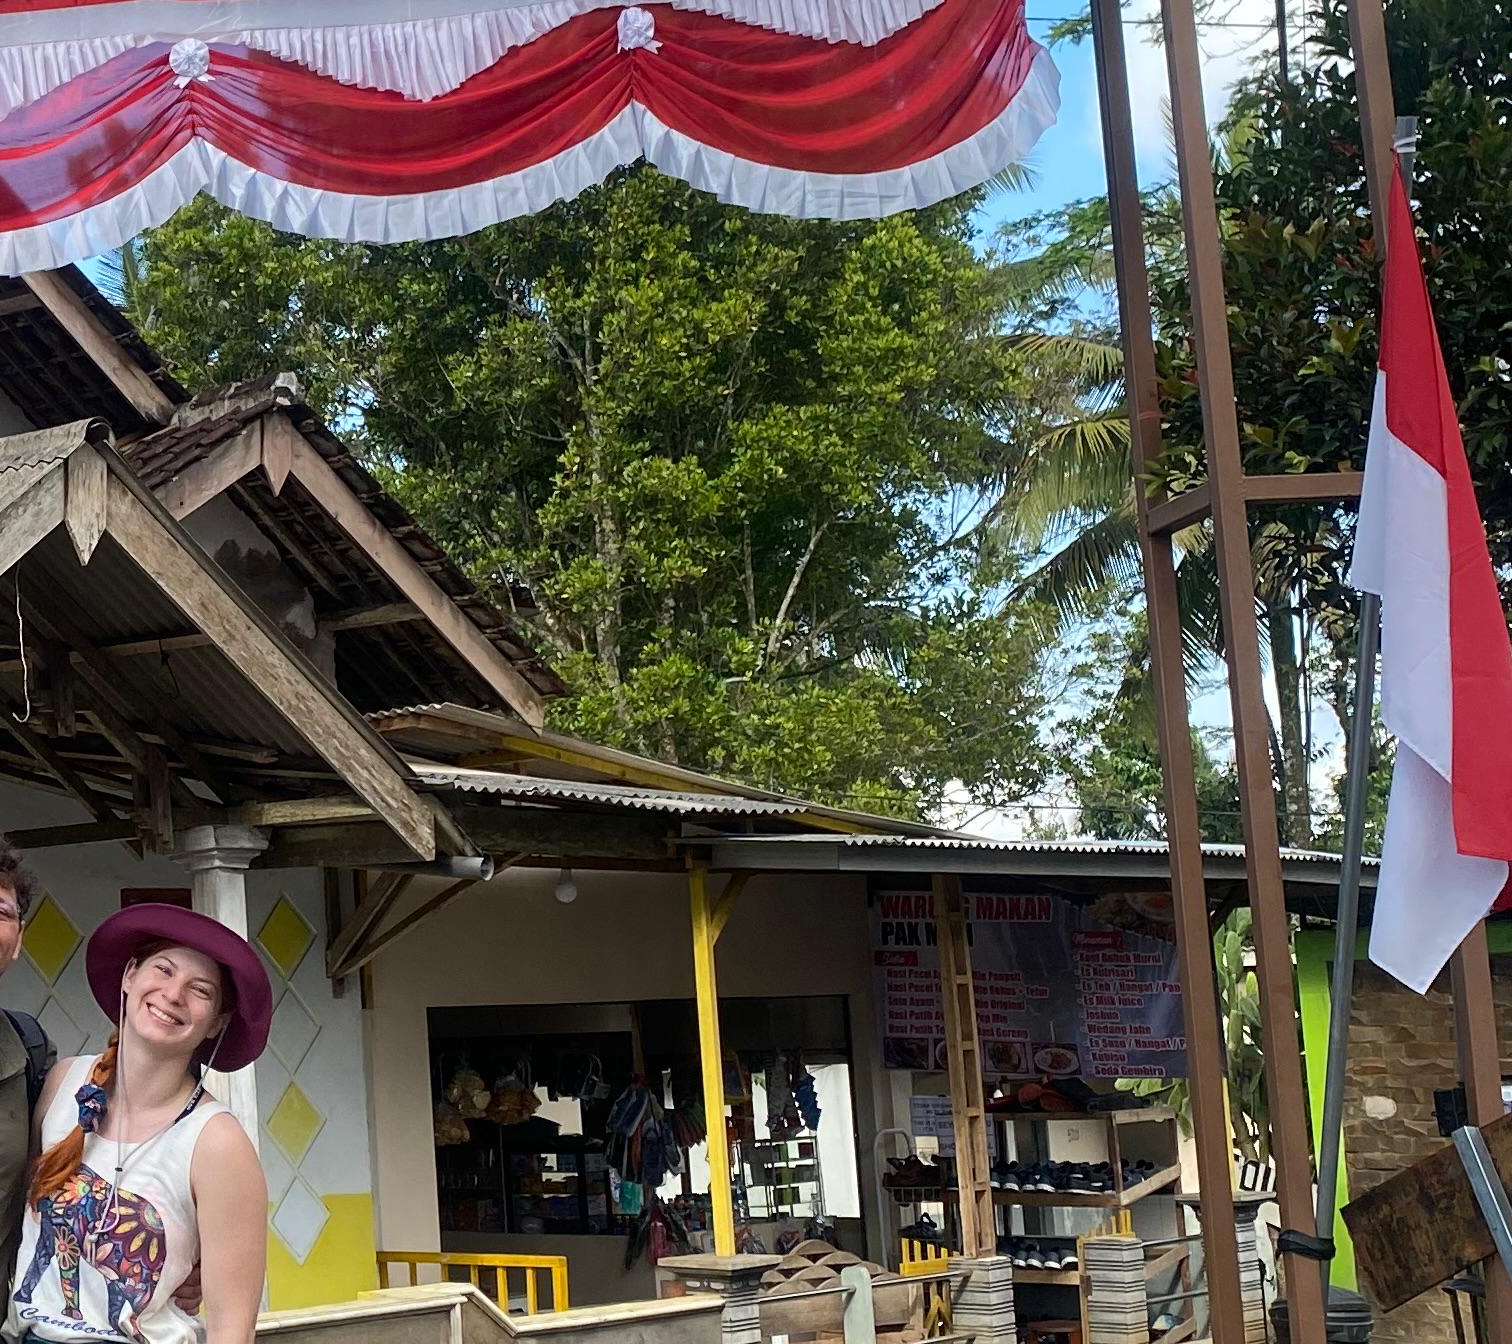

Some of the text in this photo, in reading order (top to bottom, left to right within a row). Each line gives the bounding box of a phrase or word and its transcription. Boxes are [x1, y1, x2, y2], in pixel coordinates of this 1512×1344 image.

[976, 896, 1051, 921] MAKAN
[882, 922, 921, 946] PAK
[1082, 981, 1092, 991] Es
[1095, 981, 1111, 992] Teh
[1119, 981, 1153, 994] Hangat
[1084, 996, 1094, 1005] Es
[1118, 996, 1143, 1006] Juice
[1090, 1038, 1100, 1048] Es
[1134, 1038, 1171, 1051] Hangat
[20, 1307, 119, 1336] Cambod
